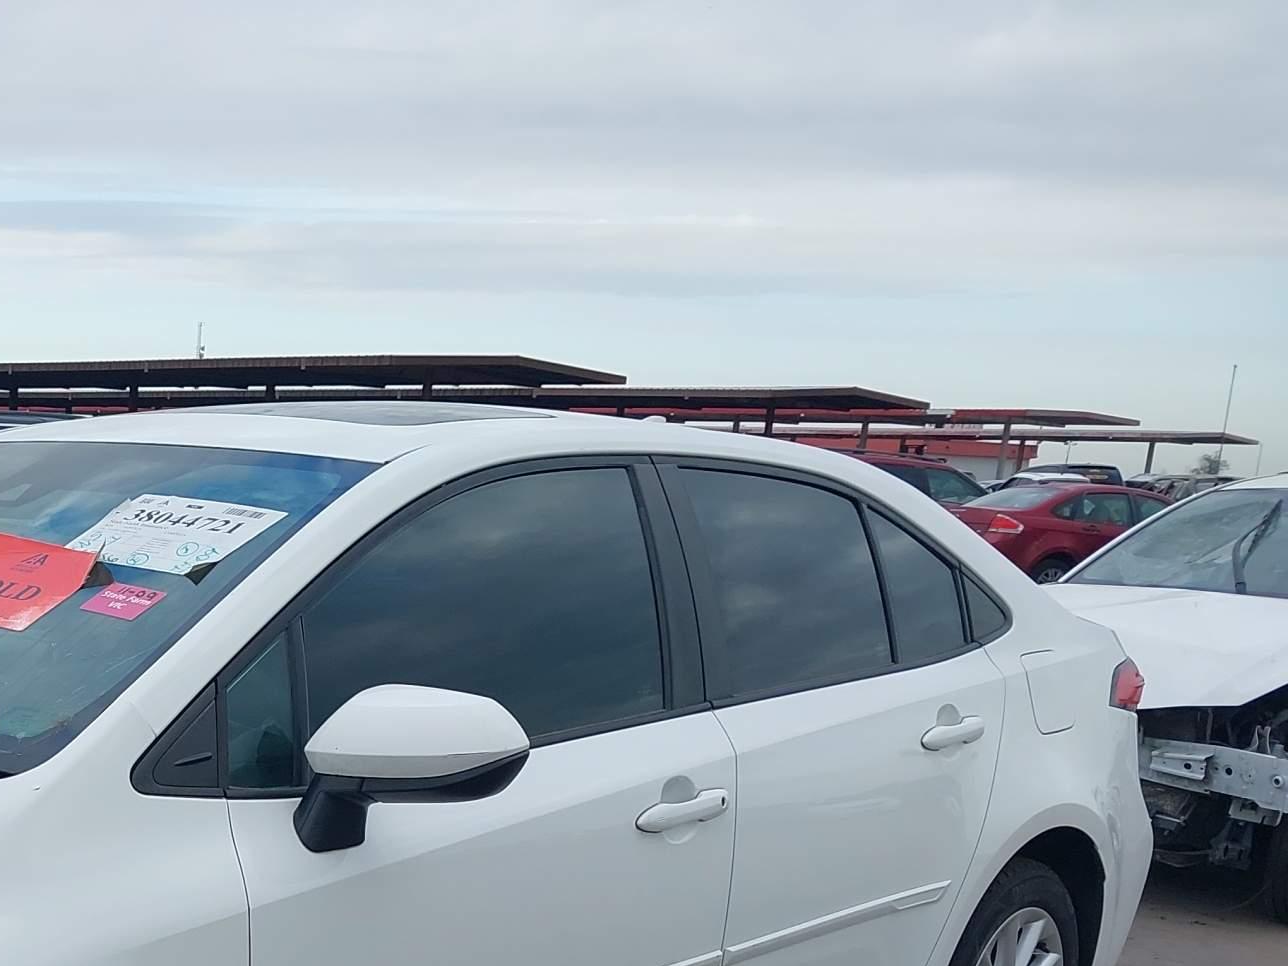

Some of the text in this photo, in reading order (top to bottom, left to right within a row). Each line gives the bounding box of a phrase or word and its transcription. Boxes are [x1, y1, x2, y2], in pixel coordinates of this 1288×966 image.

[123, 508, 246, 535] 38044721
[101, 590, 152, 606] State Farm
